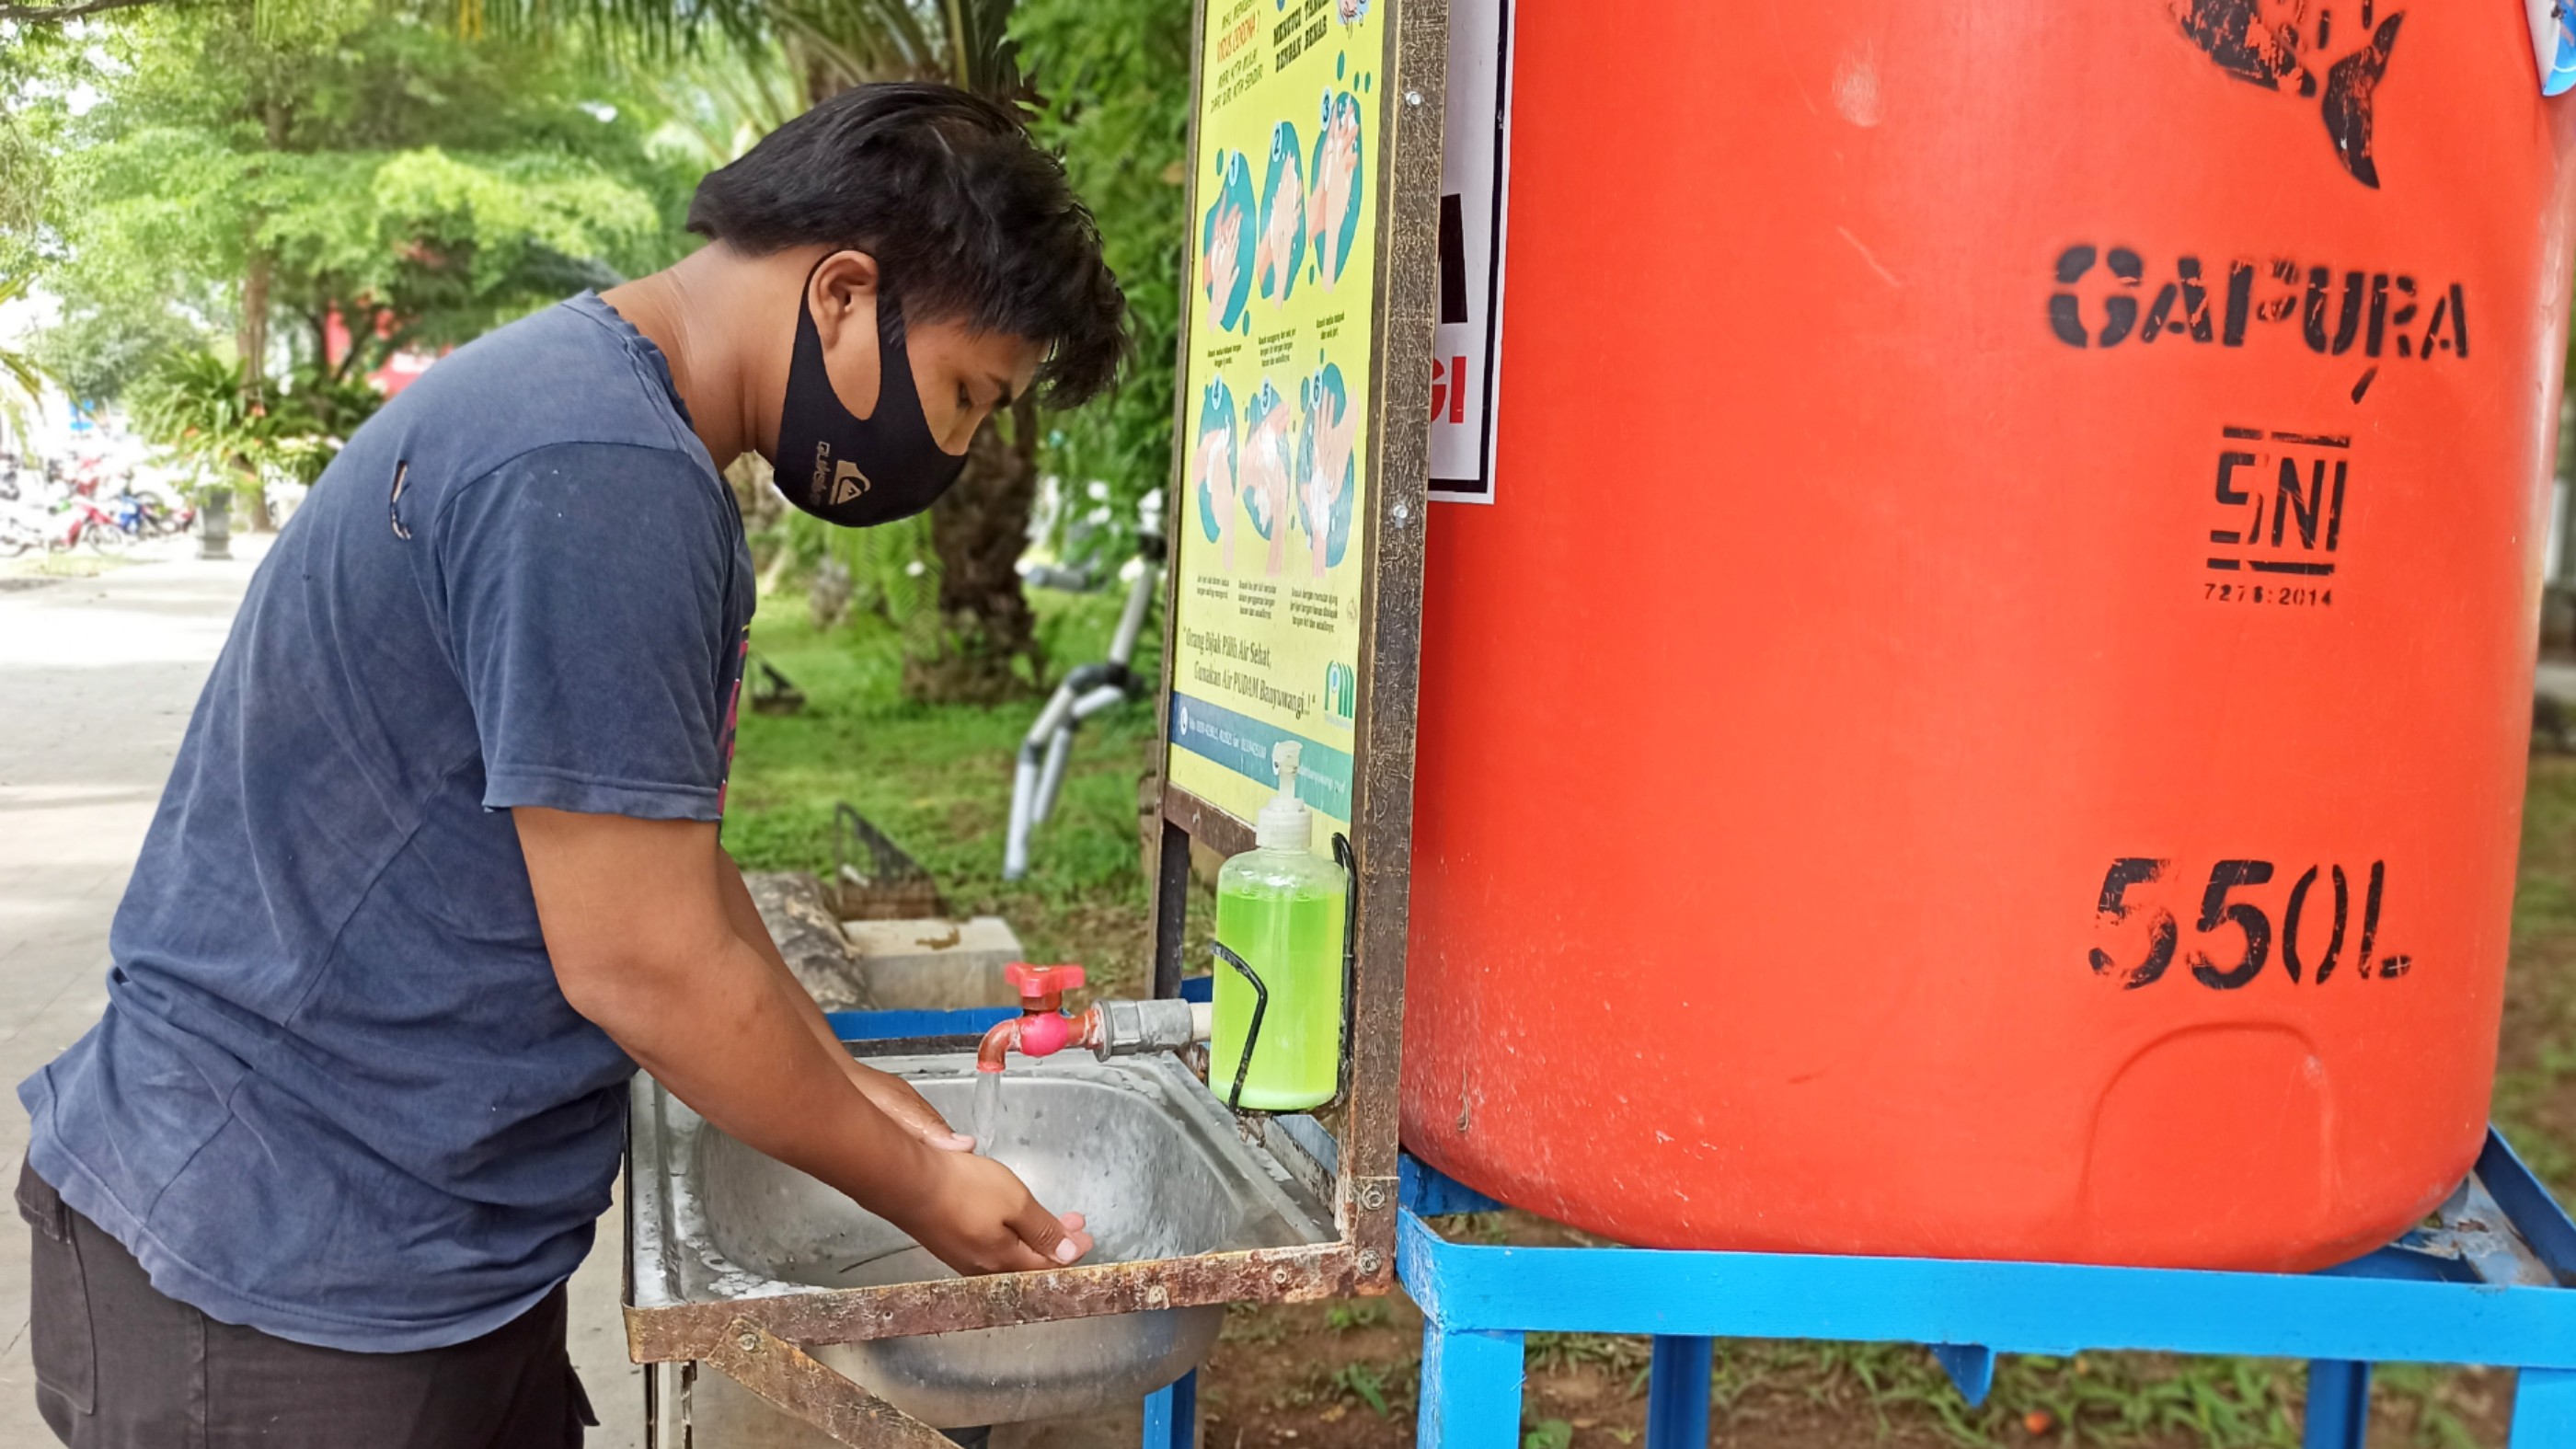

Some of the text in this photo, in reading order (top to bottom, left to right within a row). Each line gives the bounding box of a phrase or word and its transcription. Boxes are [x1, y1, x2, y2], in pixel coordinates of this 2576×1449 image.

[1305, 14, 1327, 51] BENAR
[2211, 451, 2348, 552] SNI
[1238, 639, 1248, 661] Air
[1223, 669, 1233, 689] Air
[2087, 857, 2412, 991] 550L
